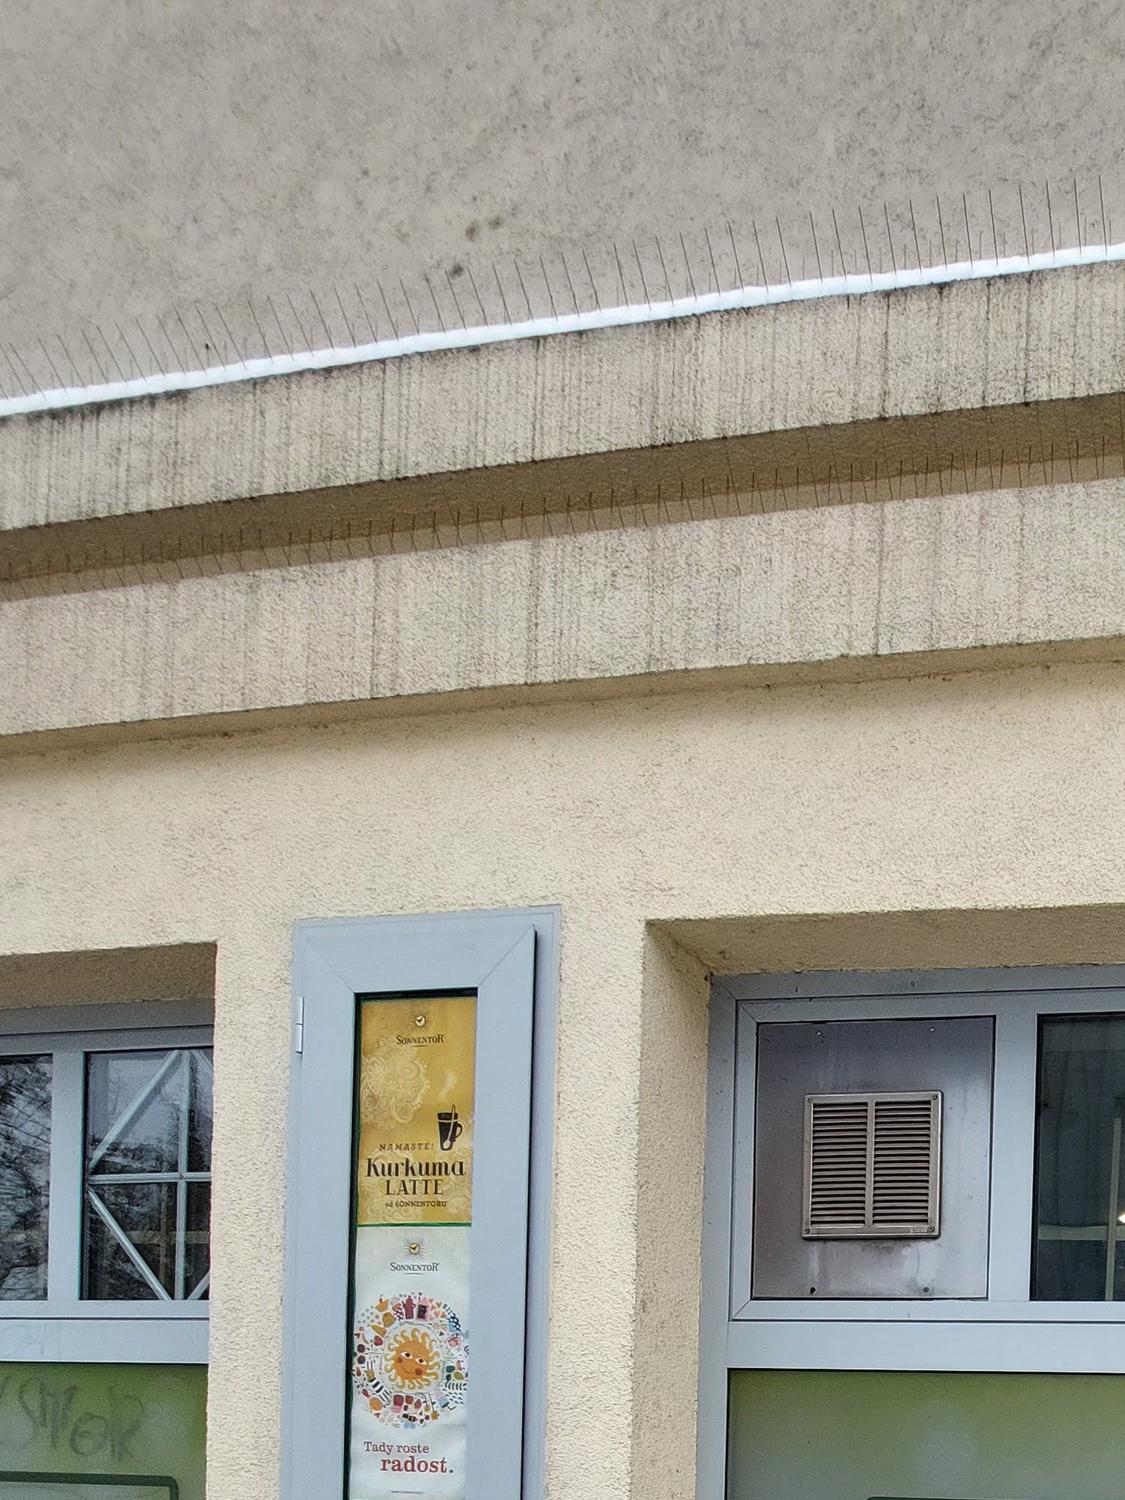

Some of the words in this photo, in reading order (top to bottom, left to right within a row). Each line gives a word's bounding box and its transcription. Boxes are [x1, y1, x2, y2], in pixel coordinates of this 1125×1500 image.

[379, 1142, 434, 1152] NAMASTE!
[366, 1157, 466, 1178] Kurkuma
[385, 1178, 444, 1196] LATTE
[364, 1441, 394, 1454] Tady
[396, 1442, 430, 1454] roste
[380, 1455, 454, 1474] radost.
